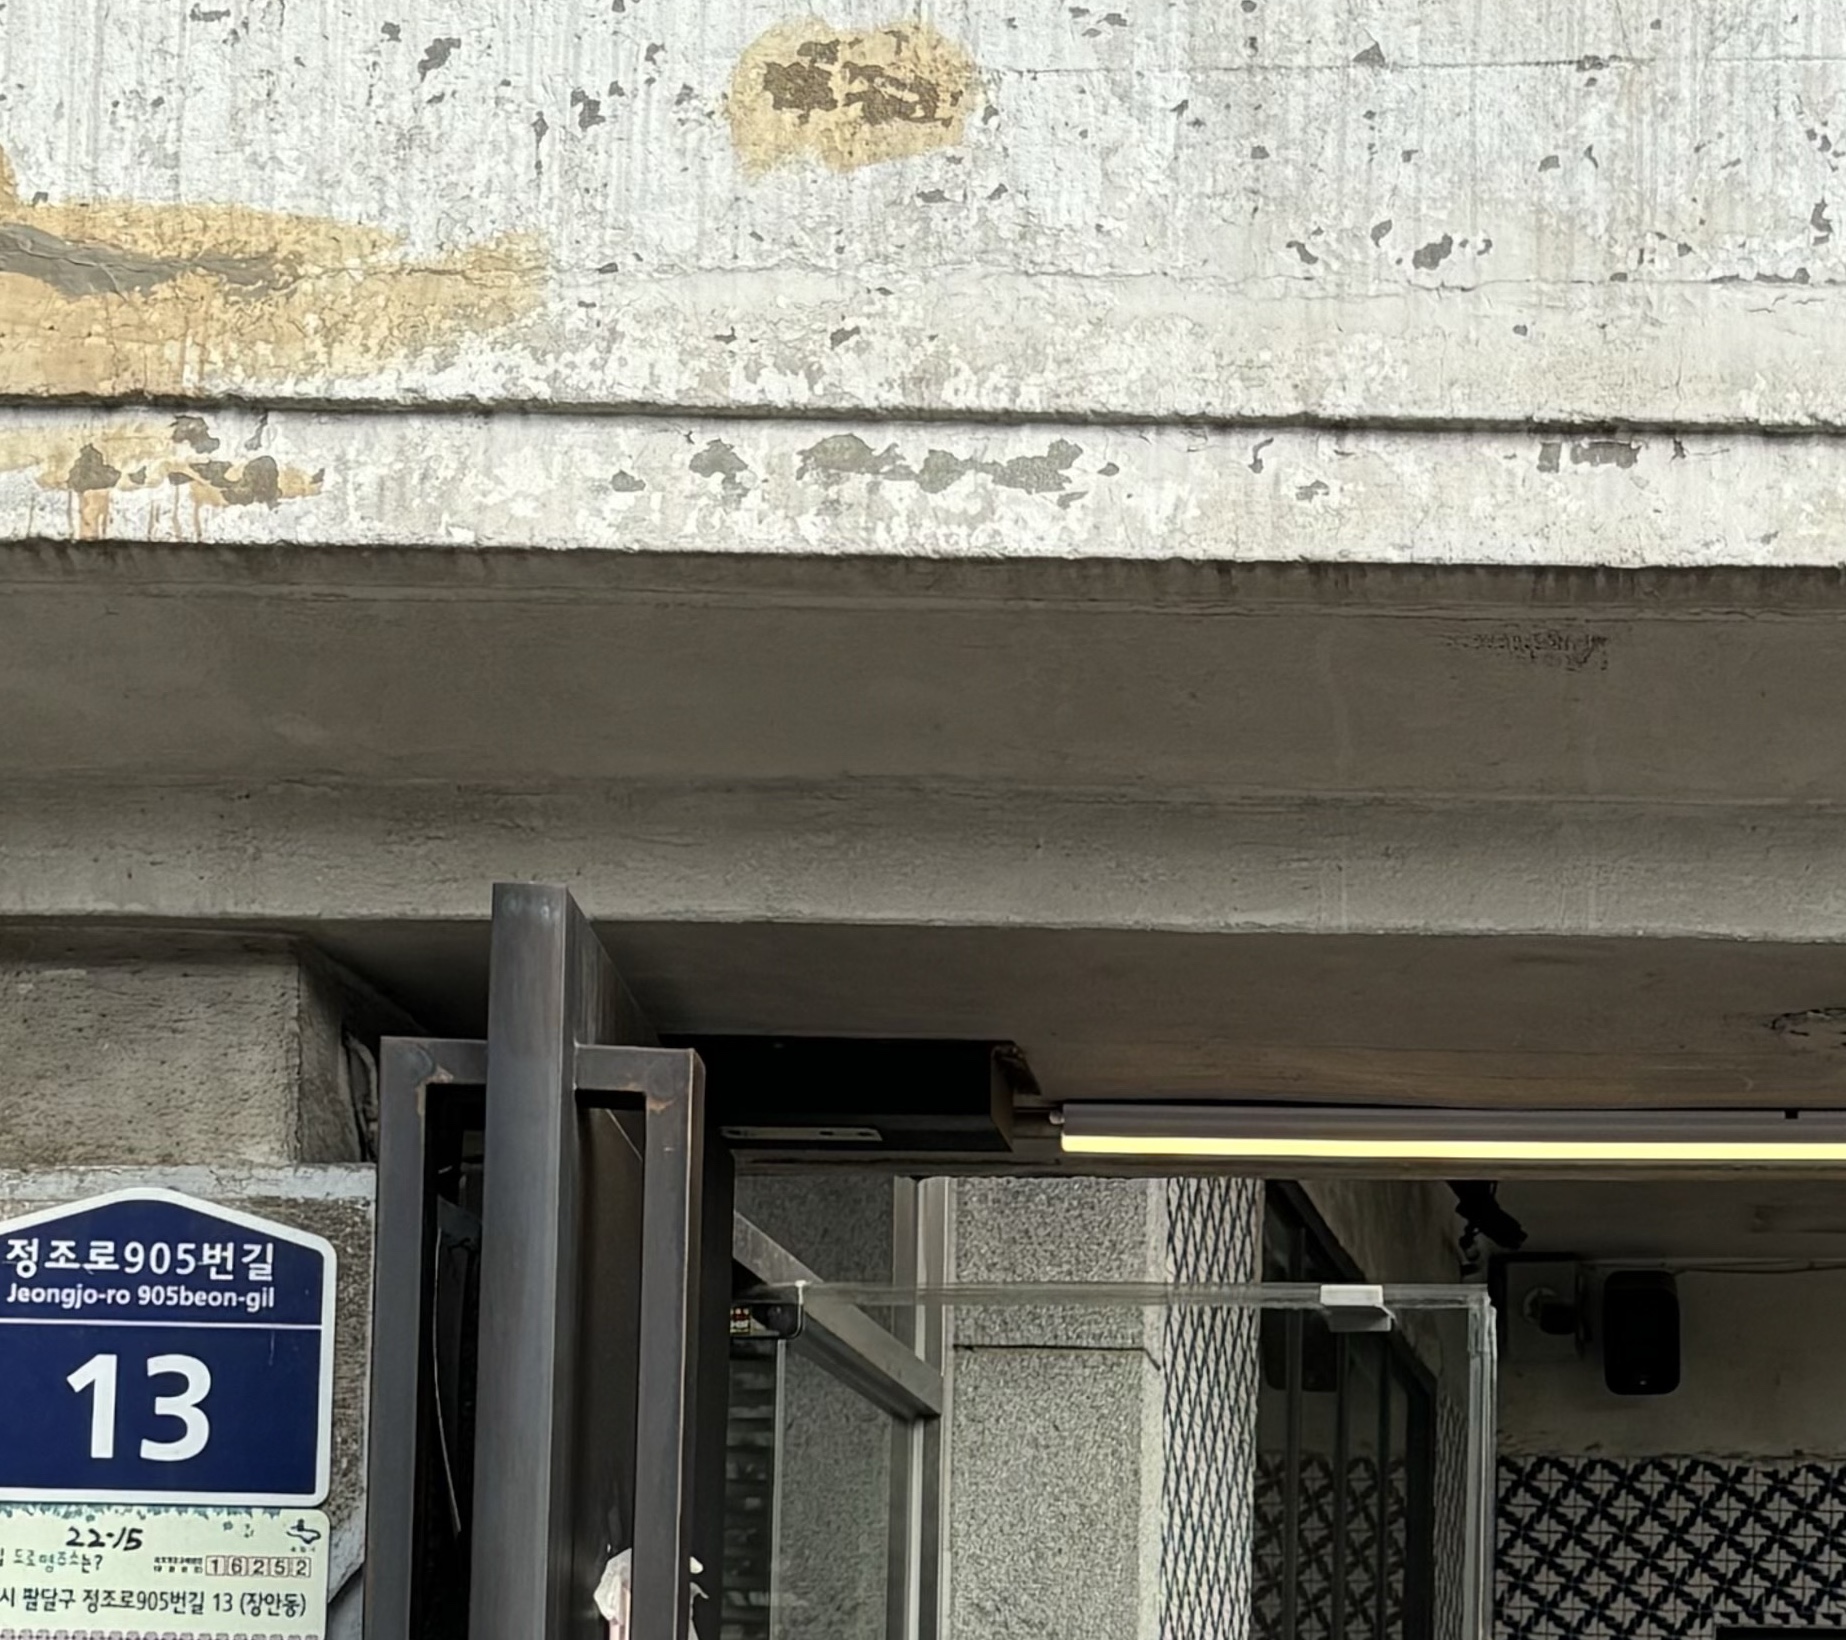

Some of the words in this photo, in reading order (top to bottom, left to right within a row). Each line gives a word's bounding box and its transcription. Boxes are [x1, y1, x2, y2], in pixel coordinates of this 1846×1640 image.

[5, 1237, 276, 1281] 정조로905번길
[6, 1283, 131, 1310] Jeongjo-ro
[137, 1285, 275, 1313] 905beon-gil
[66, 1353, 212, 1462] 13
[65, 1526, 144, 1551] 22-15
[23, 1587, 76, 1612] 팔달구
[82, 1587, 204, 1616] 정조로905번길
[213, 1592, 233, 1612] 13
[240, 1591, 306, 1618] (장안동)
